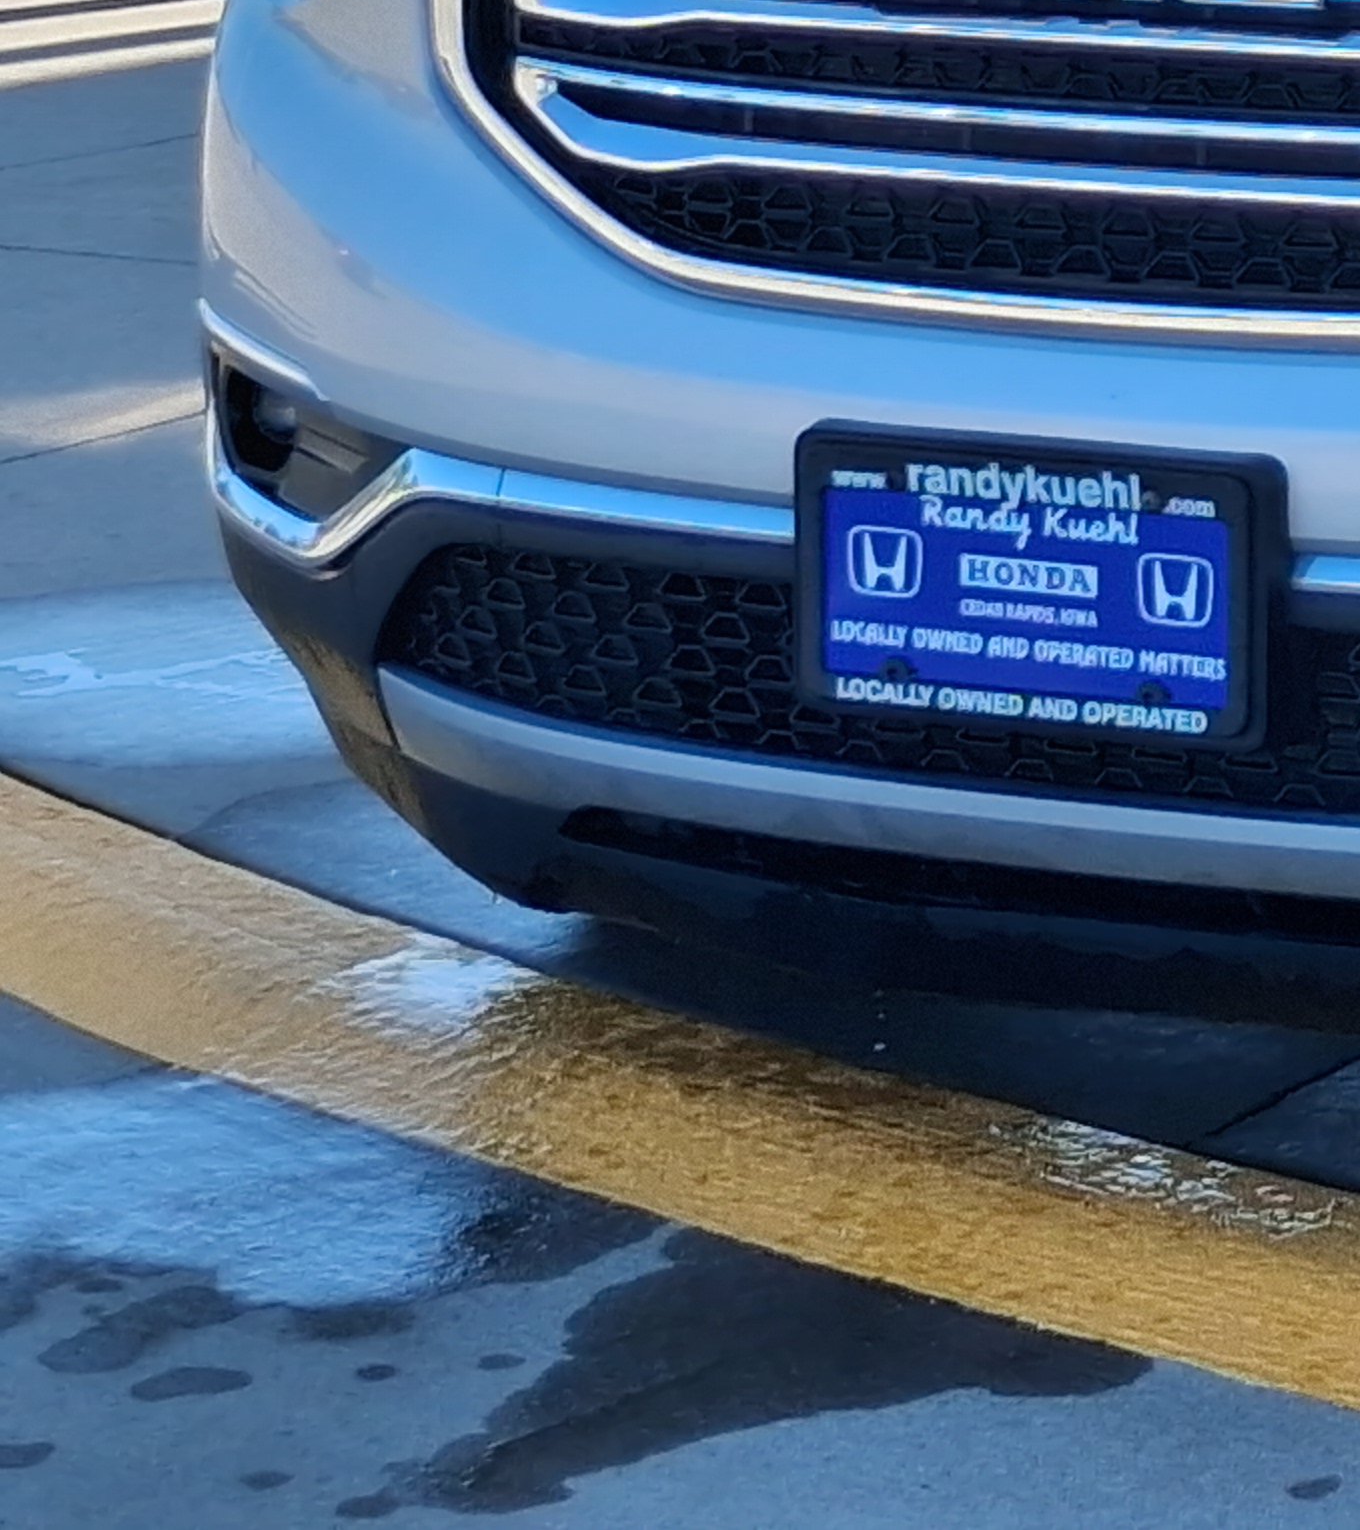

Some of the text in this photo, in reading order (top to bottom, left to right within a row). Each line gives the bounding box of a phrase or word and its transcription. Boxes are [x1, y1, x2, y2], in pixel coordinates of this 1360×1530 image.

[903, 463, 1140, 513] randykuehl
[919, 495, 1139, 550] Randy Kuehl
[966, 557, 1093, 594] HONDA
[830, 619, 1228, 683] LOCALLY OWNED AND OPERATED MATTERS
[835, 676, 1209, 736] LOCALLY OWNED AND OPERATED
